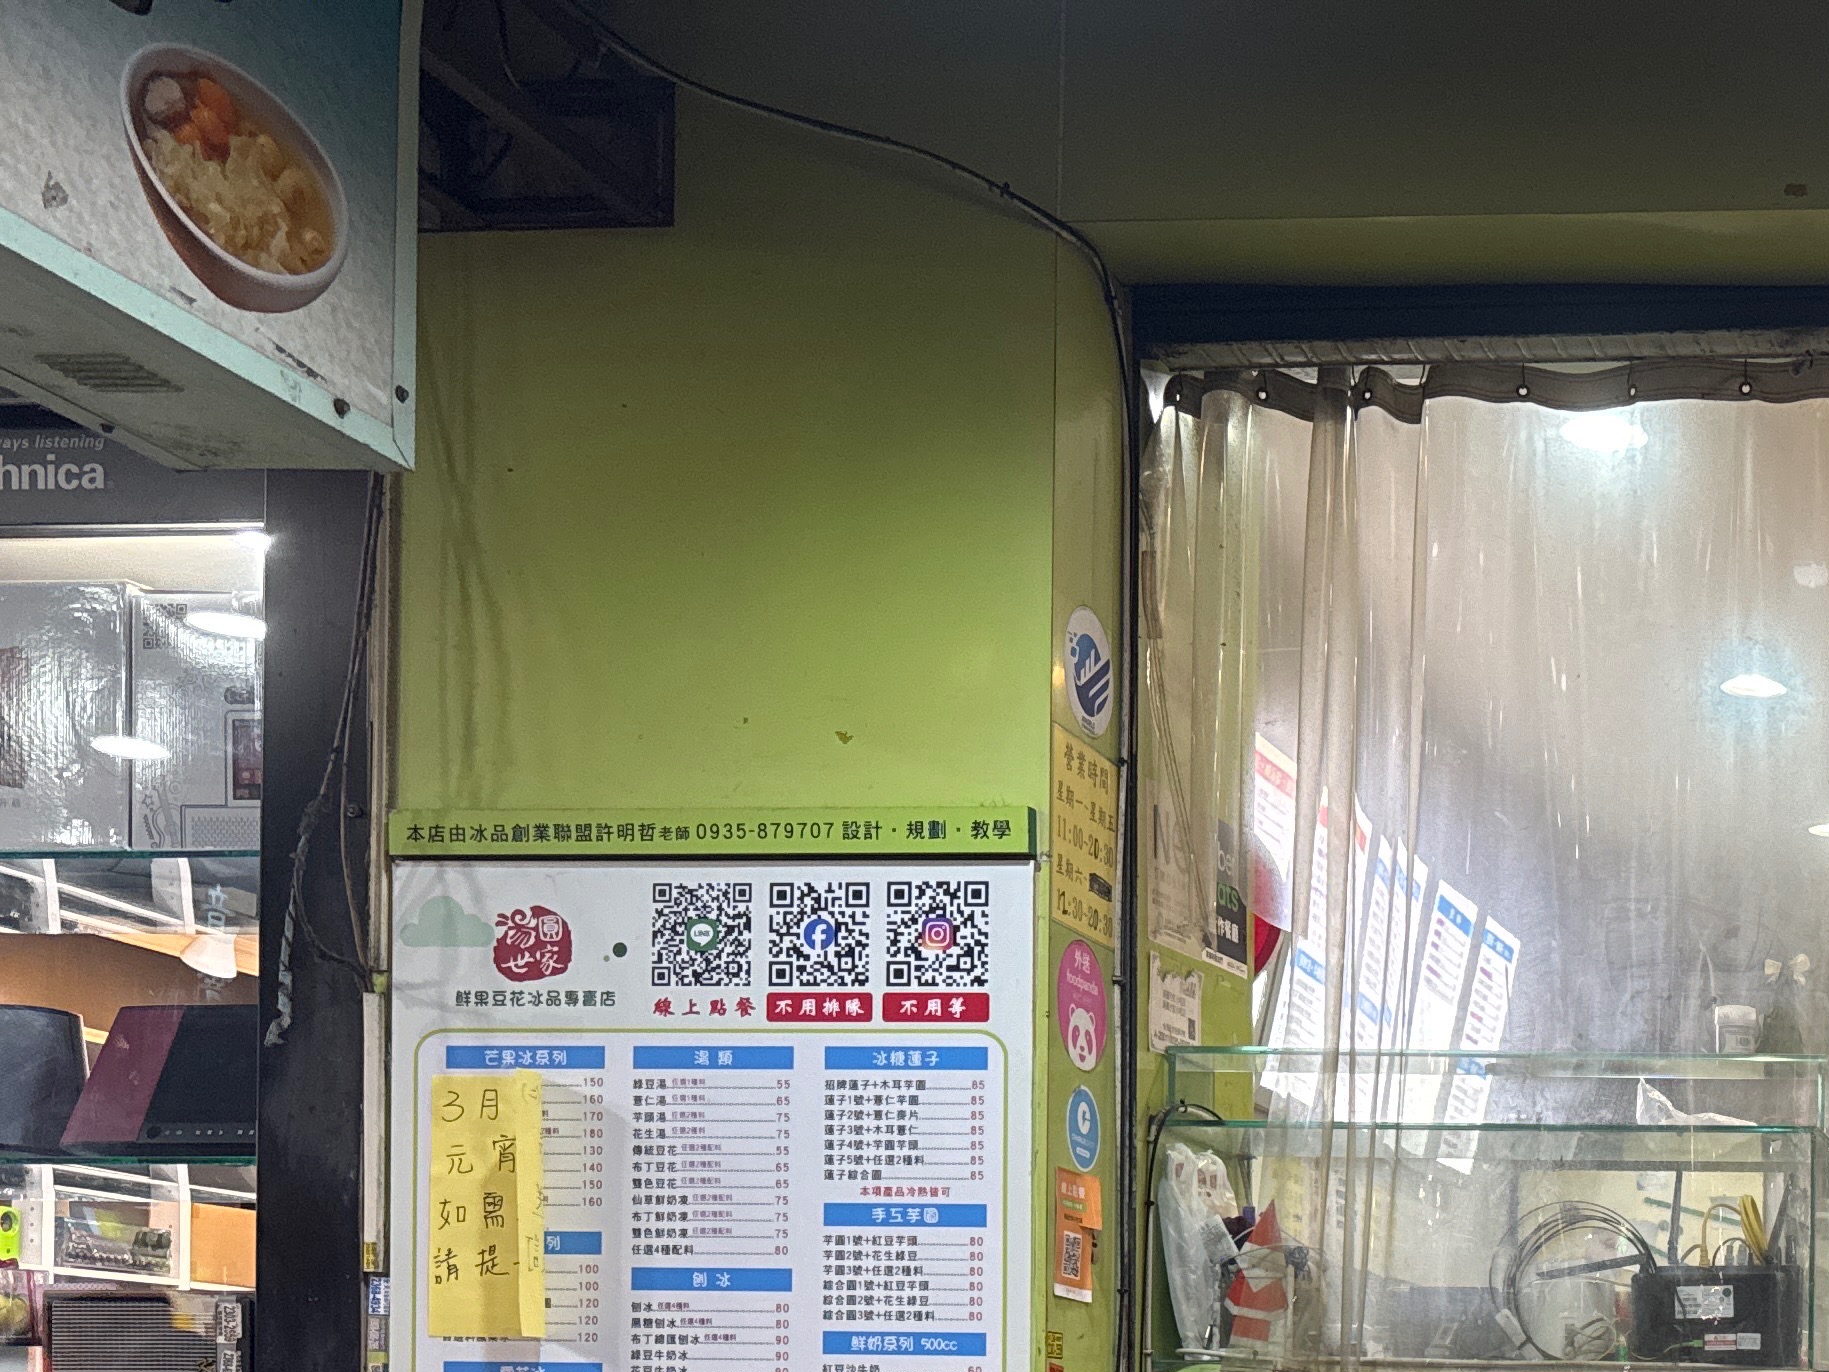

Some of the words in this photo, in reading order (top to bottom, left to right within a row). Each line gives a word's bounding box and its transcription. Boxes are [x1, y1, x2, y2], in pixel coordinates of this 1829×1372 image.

[35, 434, 105, 451] listening
[1064, 741, 1109, 795] 營業時間
[406, 822, 690, 843] 本店由冰品創業聯盟許明哲老師
[696, 822, 834, 841] 0935-879707
[455, 990, 616, 1007] 鮮果豆花冰品專賣店
[653, 997, 756, 1017] 線上點餐
[775, 997, 865, 1018] 不用排隊
[899, 997, 967, 1018] 不用等
[484, 1049, 567, 1066] 芒果冰系列
[872, 1050, 940, 1067] 冰糖蓮子
[583, 1078, 603, 1088] 150
[777, 1080, 790, 1089] 55
[971, 1080, 985, 1091] 85
[442, 1088, 499, 1122] 3月
[632, 1129, 666, 1139] 花生湯
[776, 1130, 790, 1139] 75
[970, 1156, 984, 1166] 85
[632, 1162, 677, 1172] 布丁豆花
[776, 1163, 789, 1172] 65
[775, 1246, 788, 1255] 80
[578, 1264, 599, 1274] 100
[969, 1266, 983, 1276] 80
[692, 1271, 732, 1288] 刨冰
[775, 1303, 790, 1313] 80
[851, 1335, 914, 1351] 鮮奶系列
[920, 1338, 958, 1351] 500cc
